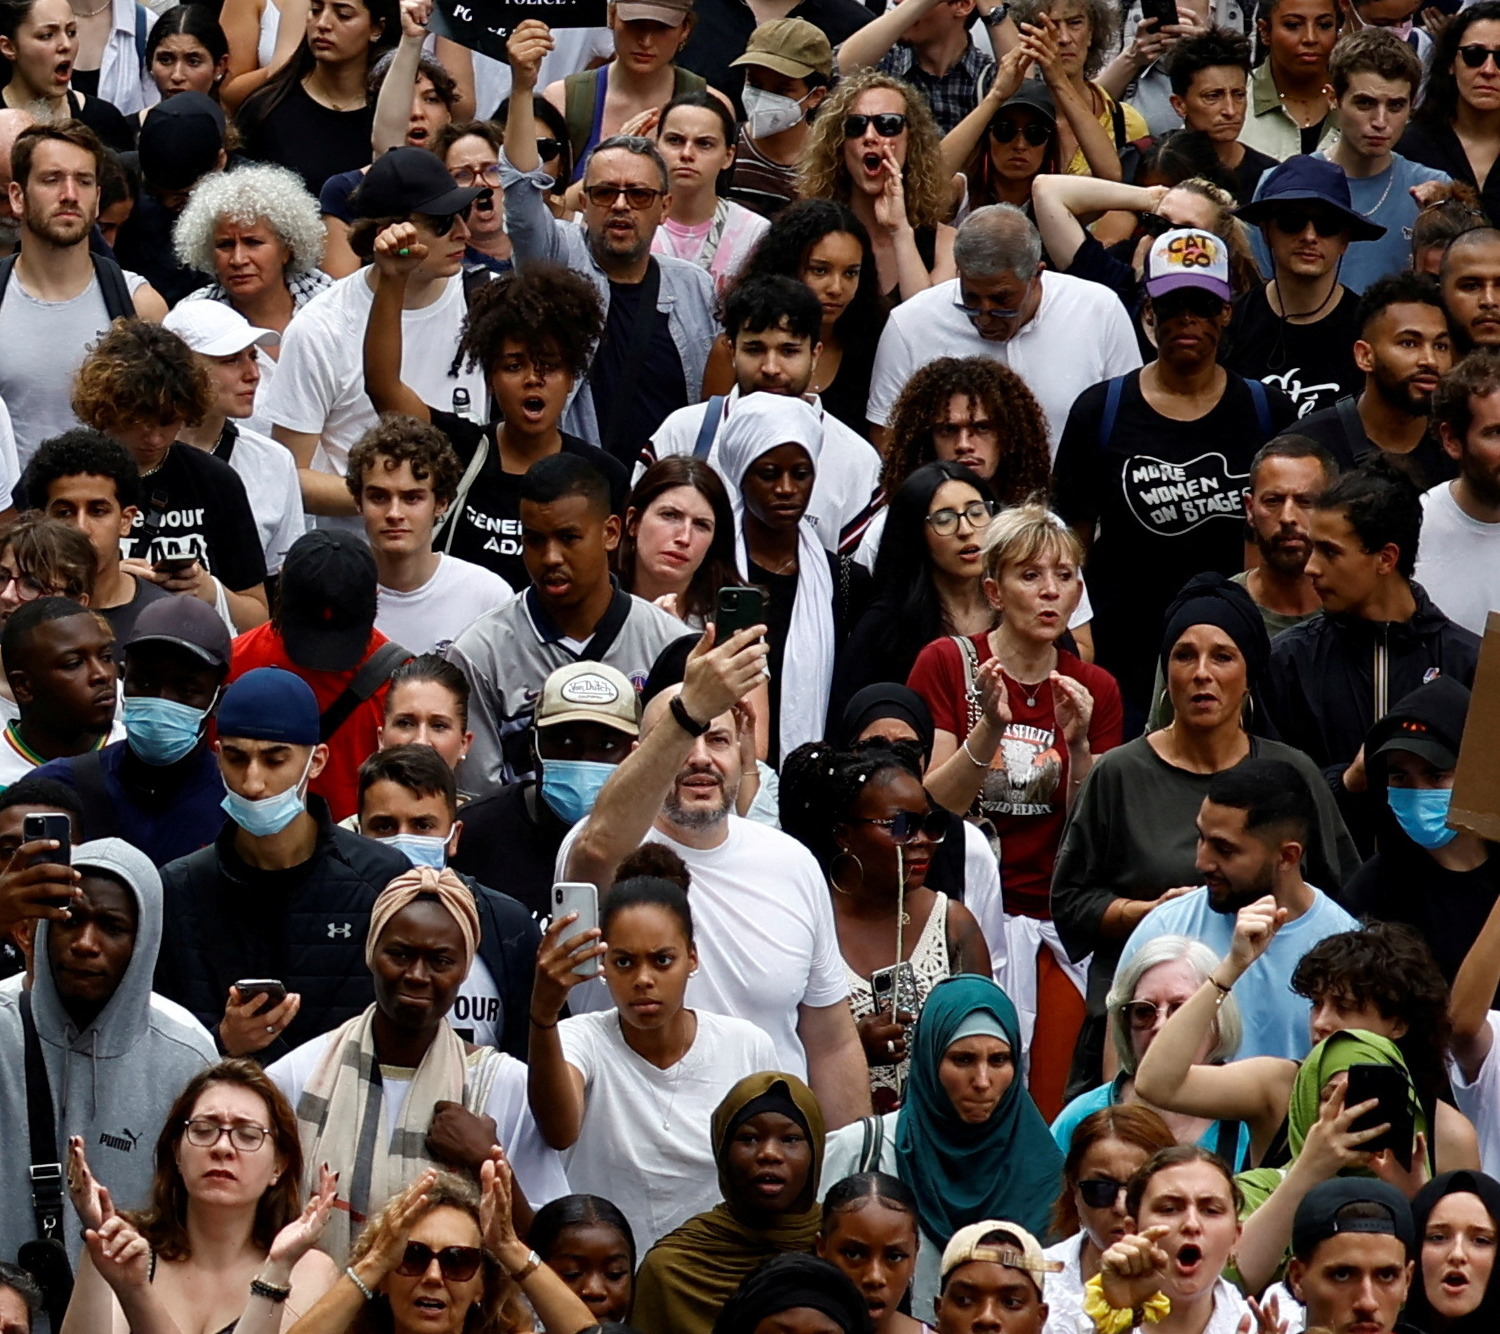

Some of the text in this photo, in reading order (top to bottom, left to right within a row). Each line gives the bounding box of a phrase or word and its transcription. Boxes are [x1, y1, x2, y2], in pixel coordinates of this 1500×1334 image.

[1168, 234, 1210, 254] CAT
[1182, 251, 1211, 269] 60
[1131, 462, 1187, 486] MORE
[1140, 476, 1221, 507] WOMEN
[1150, 492, 1245, 526] ON STAGE
[586, 679, 613, 696] Dutch
[1012, 802, 1053, 817] HEART
[454, 995, 501, 1023] OUR
[99, 1132, 132, 1153] PUMA
